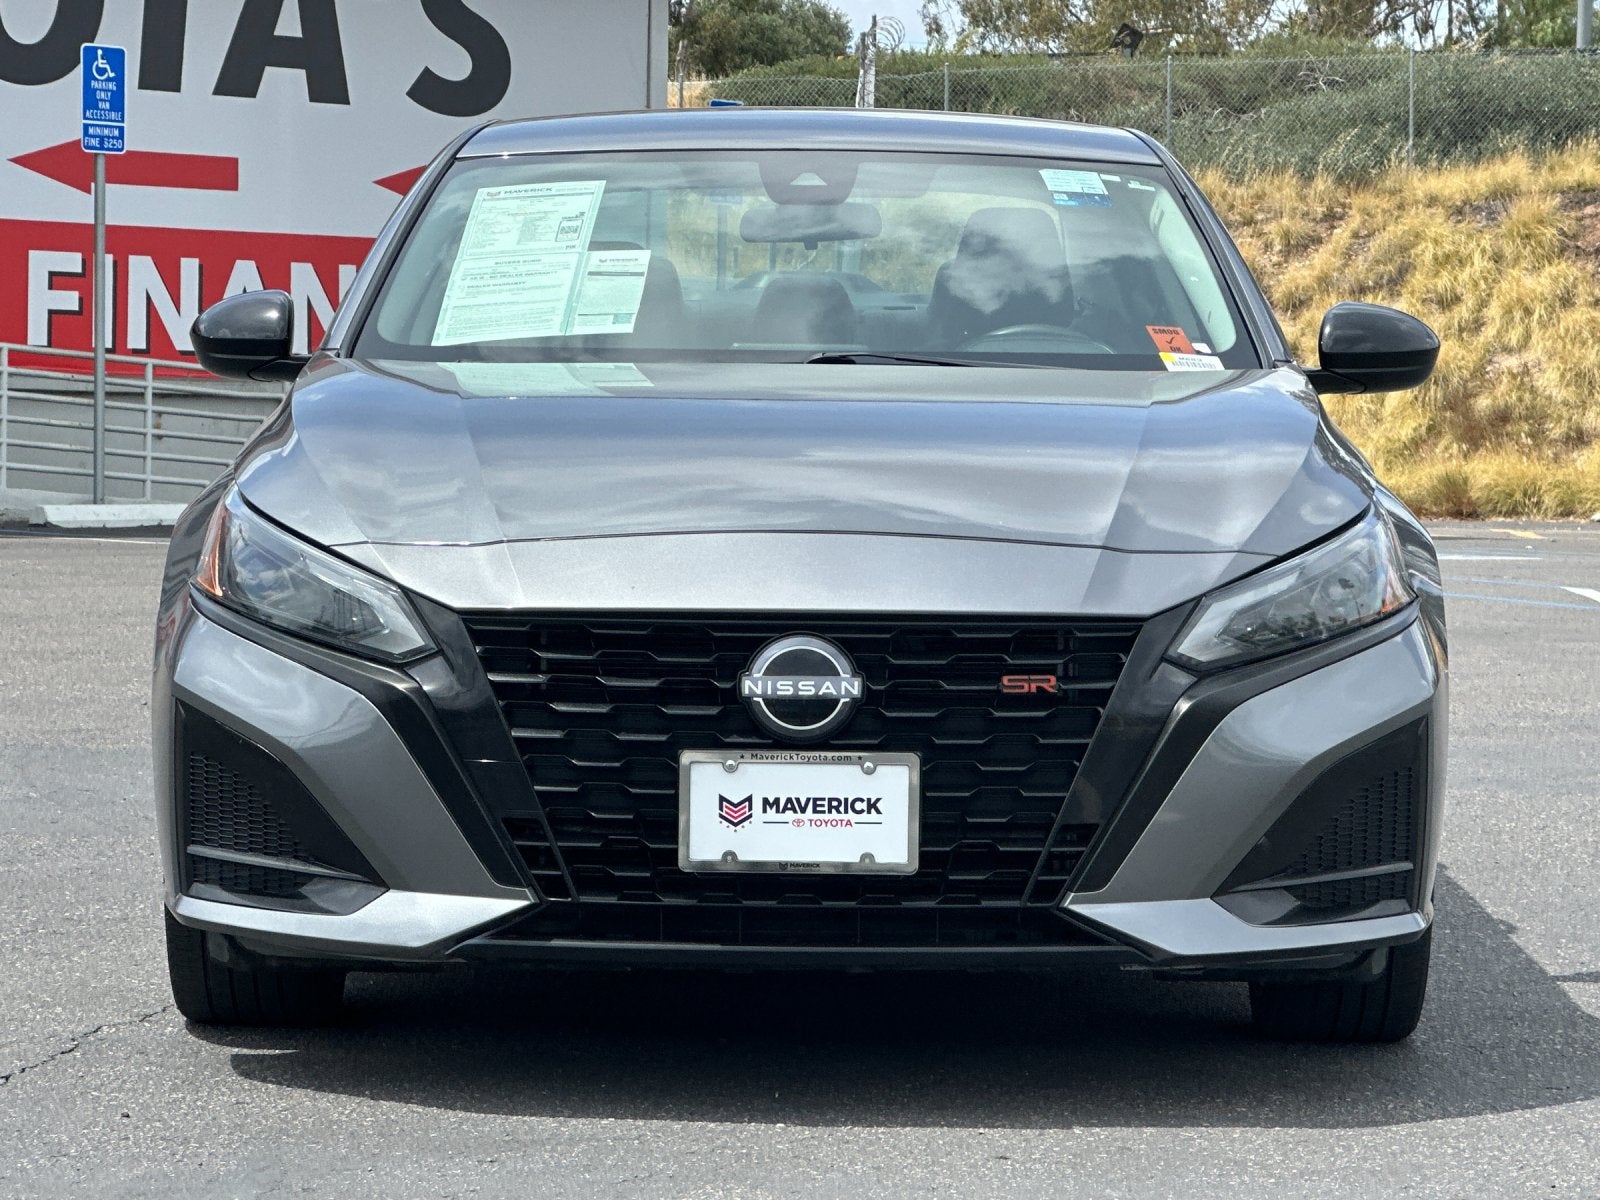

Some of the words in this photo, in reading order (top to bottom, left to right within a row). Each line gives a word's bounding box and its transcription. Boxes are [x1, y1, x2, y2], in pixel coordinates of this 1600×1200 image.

[91, 80, 117, 90] PARKING
[96, 90, 111, 101] ONLY
[98, 101, 110, 110] VAN
[85, 109, 122, 121] ACCESSIBLE
[88, 126, 119, 137] MINIMUM
[84, 137, 100, 147] FINE
[103, 138, 123, 149] $250
[744, 680, 859, 696] NISSAN
[1001, 674, 1056, 693] SR
[750, 753, 852, 762] MaverickToyota.com
[762, 797, 882, 815] MAVERICK
[807, 819, 853, 828] TOYOTA
